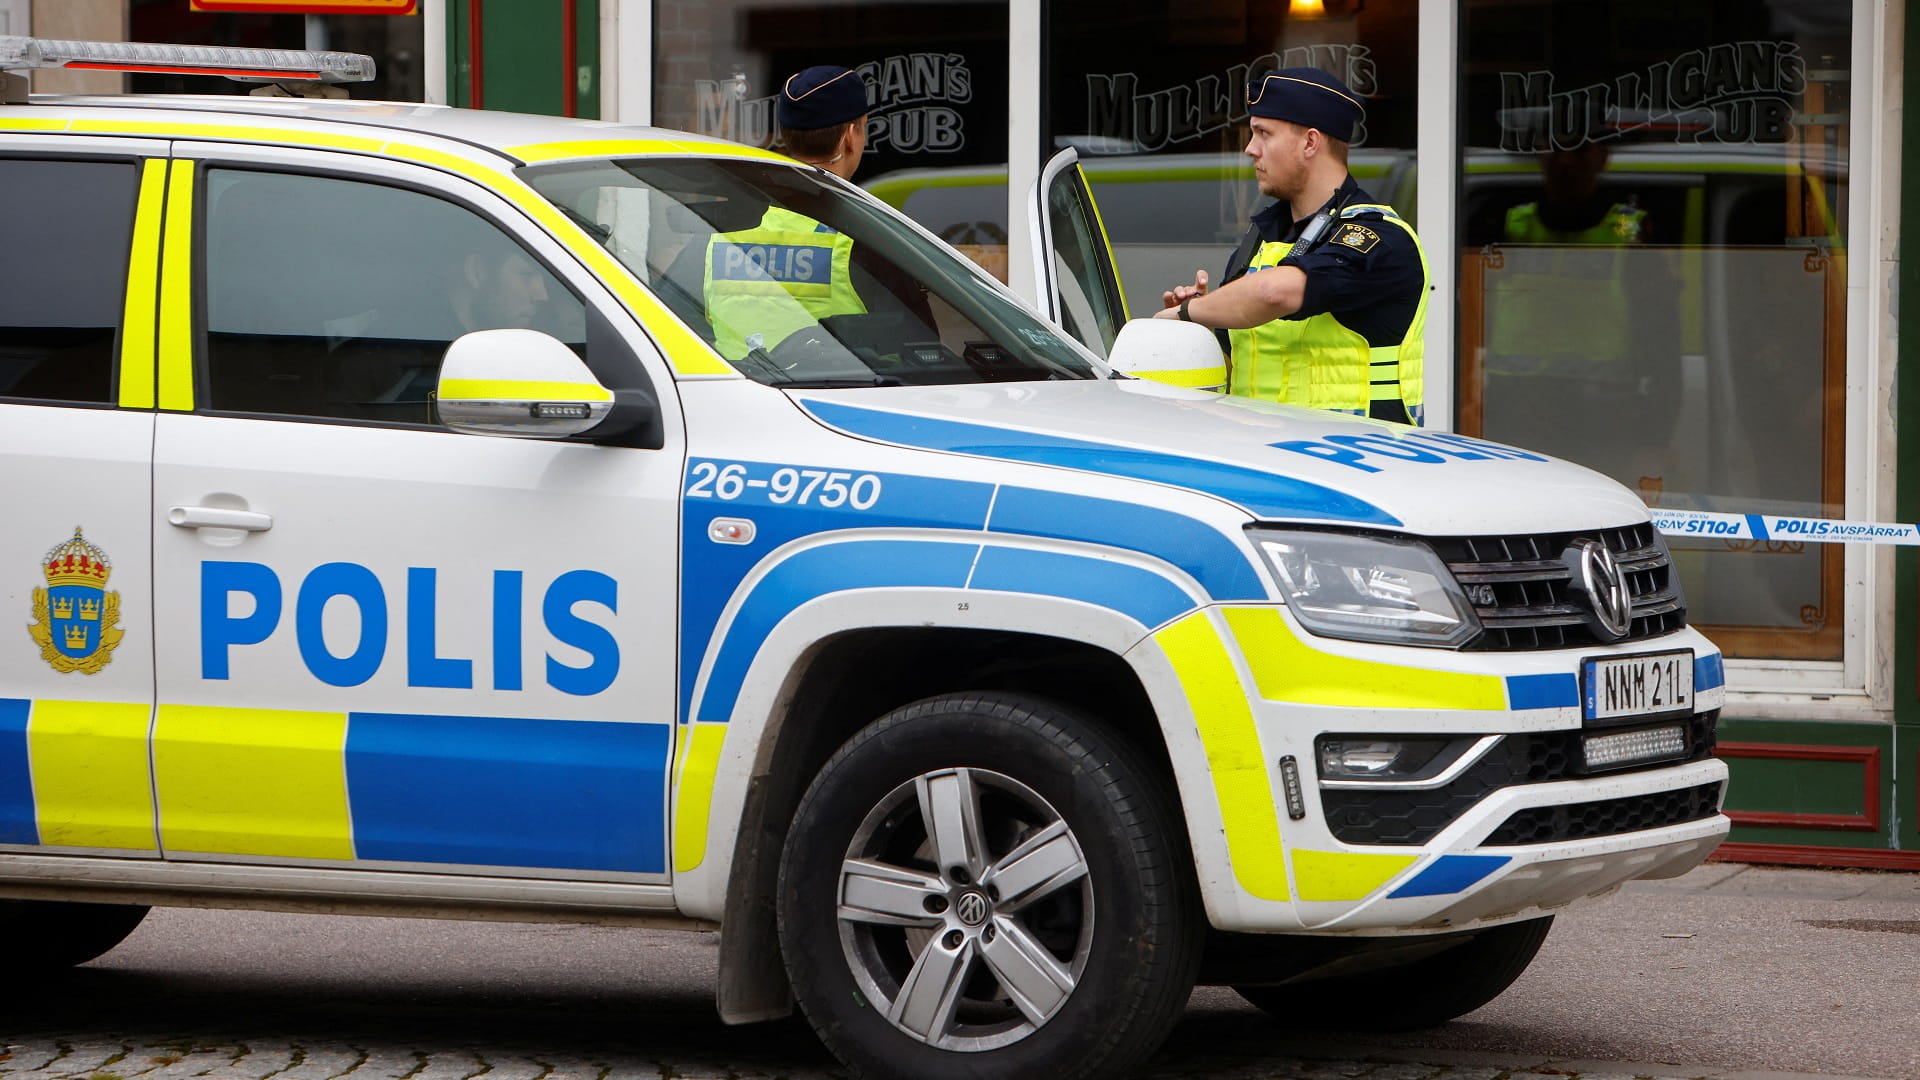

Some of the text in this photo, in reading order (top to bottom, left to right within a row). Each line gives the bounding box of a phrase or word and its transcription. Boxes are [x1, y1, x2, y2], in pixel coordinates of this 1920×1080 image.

[864, 106, 965, 153] PUB
[1675, 98, 1796, 145] PUB
[1346, 225, 1377, 239] POLIS
[725, 246, 814, 280] POLIS
[1265, 433, 1550, 473] POLIS
[686, 462, 882, 510] 26-9750
[1685, 519, 1741, 534] POLIS
[1775, 519, 1912, 537] POLIS AVSPÄRRAT
[201, 560, 620, 696] POLIS
[1606, 659, 1685, 711] NNM 21L
